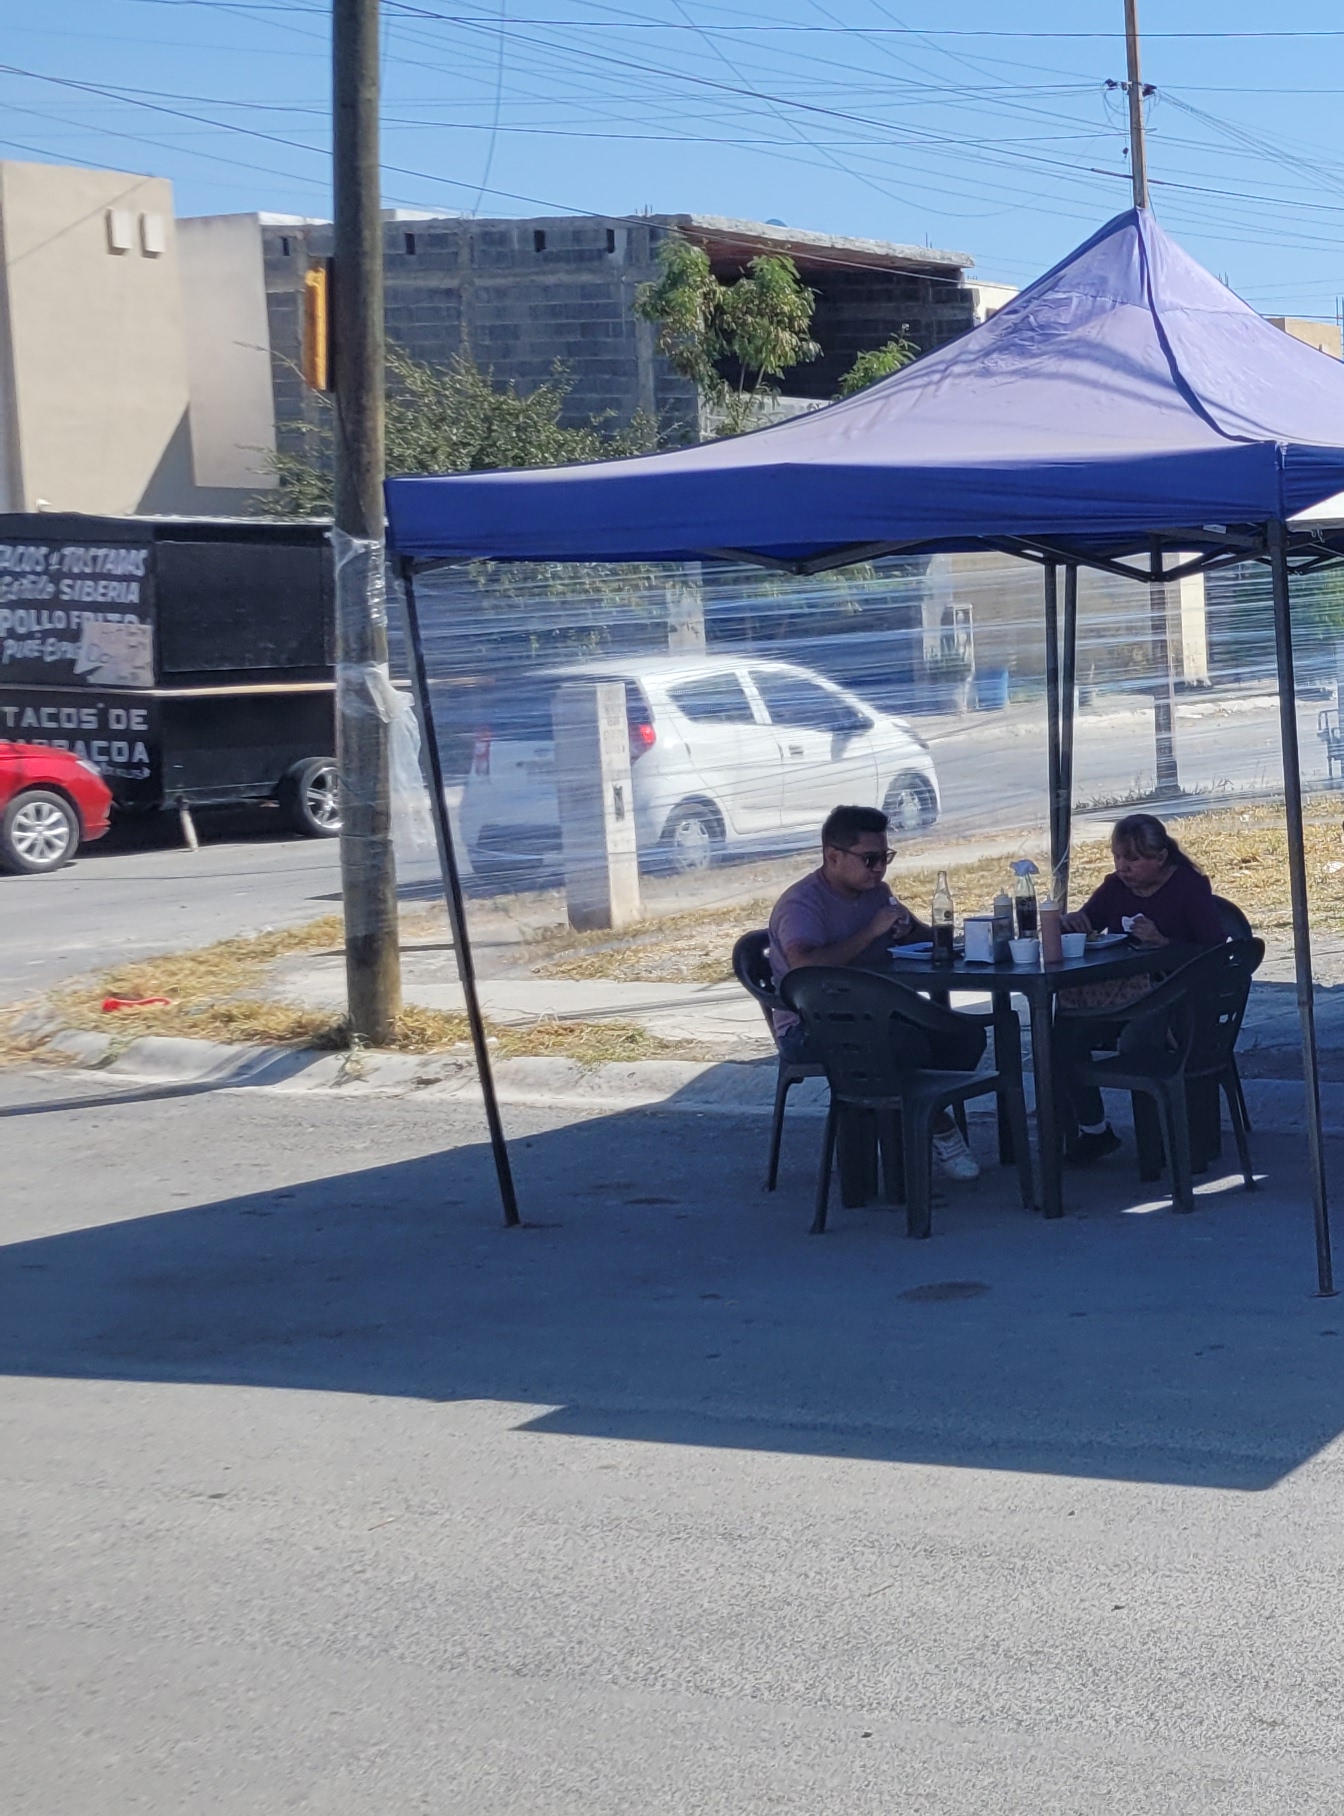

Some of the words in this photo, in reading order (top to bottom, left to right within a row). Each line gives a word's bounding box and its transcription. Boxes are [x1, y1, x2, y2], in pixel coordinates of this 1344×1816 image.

[59, 579, 140, 603] SIBERIA
[0, 608, 68, 637] POLLO
[1, 706, 99, 730] TACOS
[108, 708, 149, 731] DE
